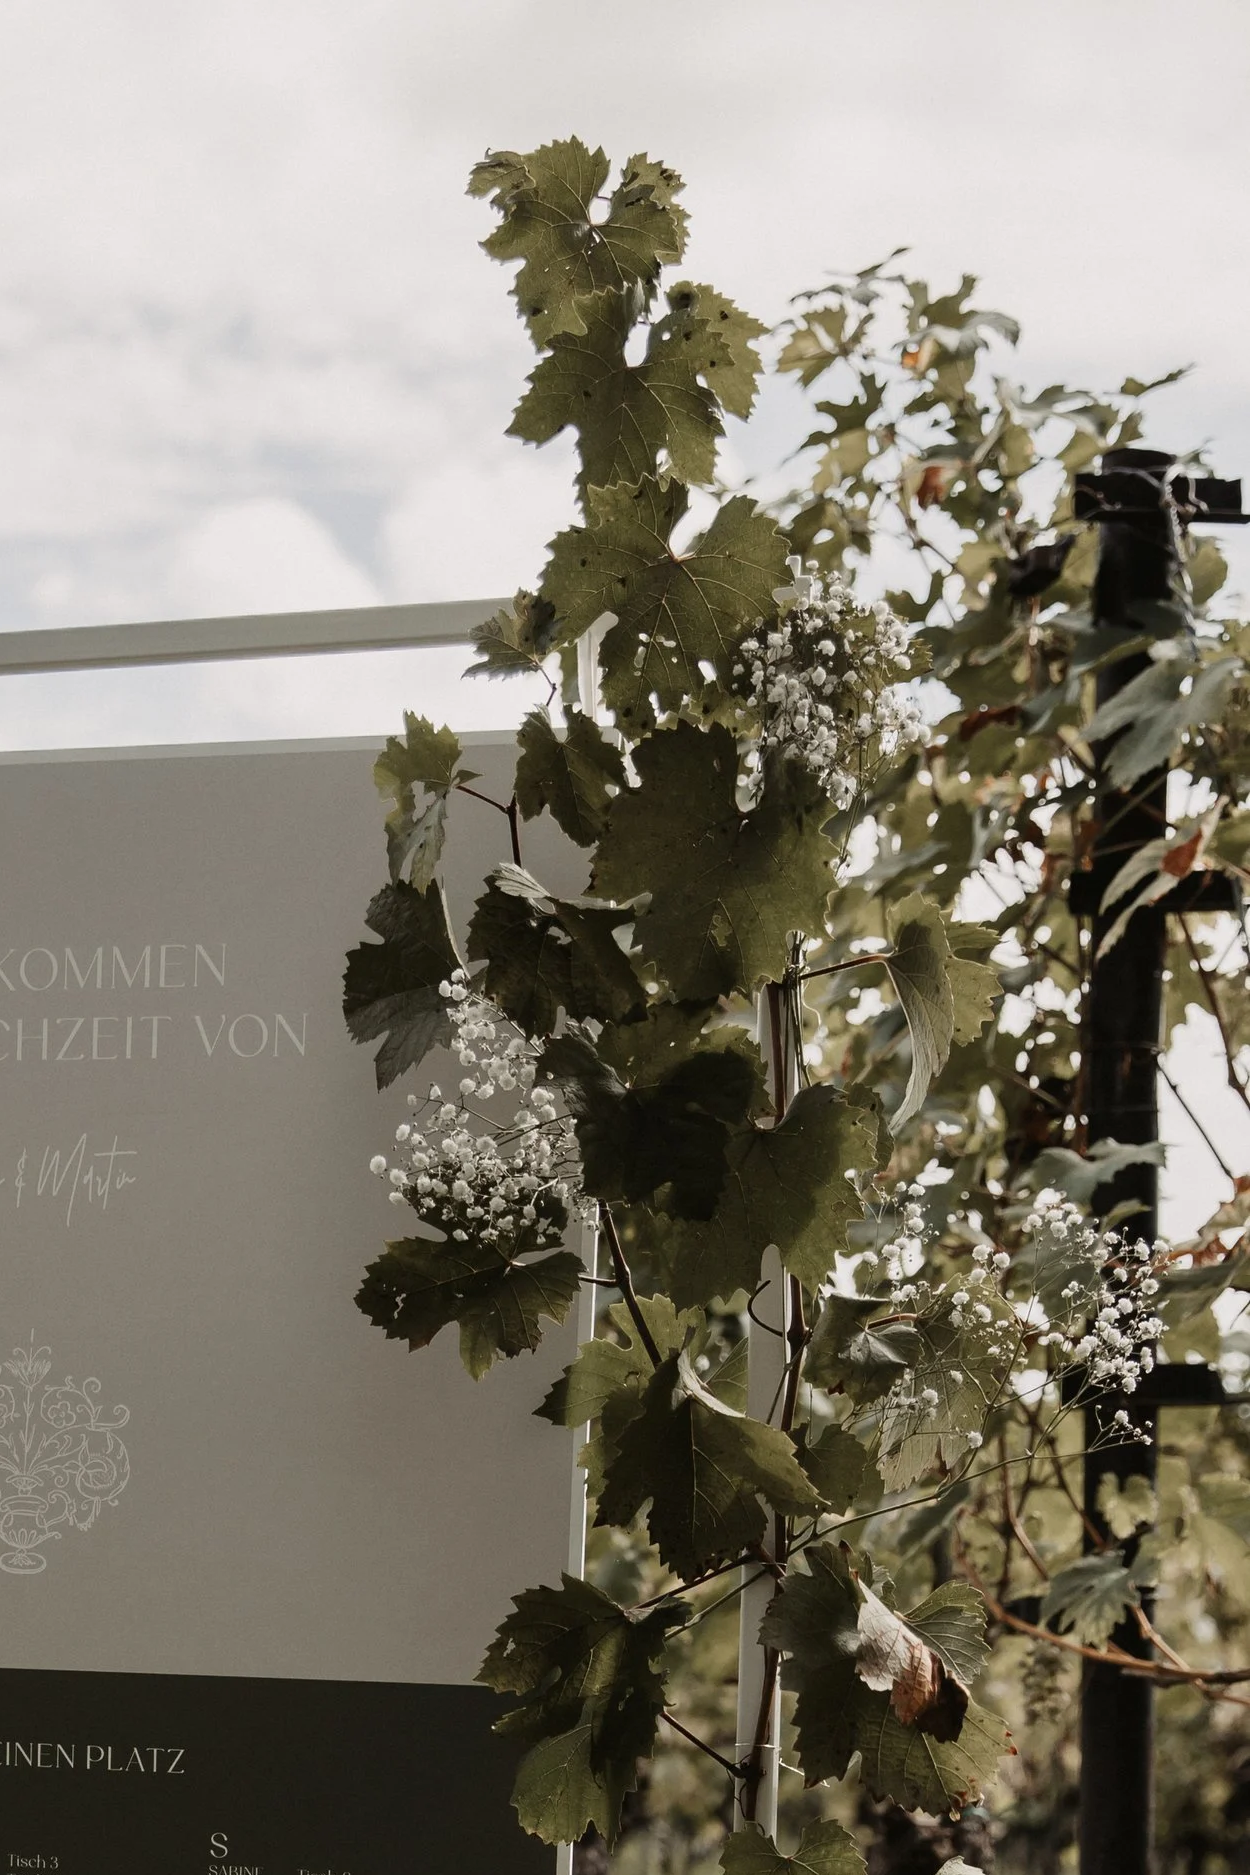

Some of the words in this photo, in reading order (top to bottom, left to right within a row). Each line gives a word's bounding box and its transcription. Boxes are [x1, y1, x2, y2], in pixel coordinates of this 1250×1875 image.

[194, 1013, 308, 1059] VON
[14, 1148, 27, 1208] &
[37, 1133, 137, 1227] Martin
[86, 1745, 185, 1774] PLATZ
[210, 1832, 228, 1859] S
[7, 1854, 46, 1869] Tisch
[49, 1856, 59, 1869] 3
